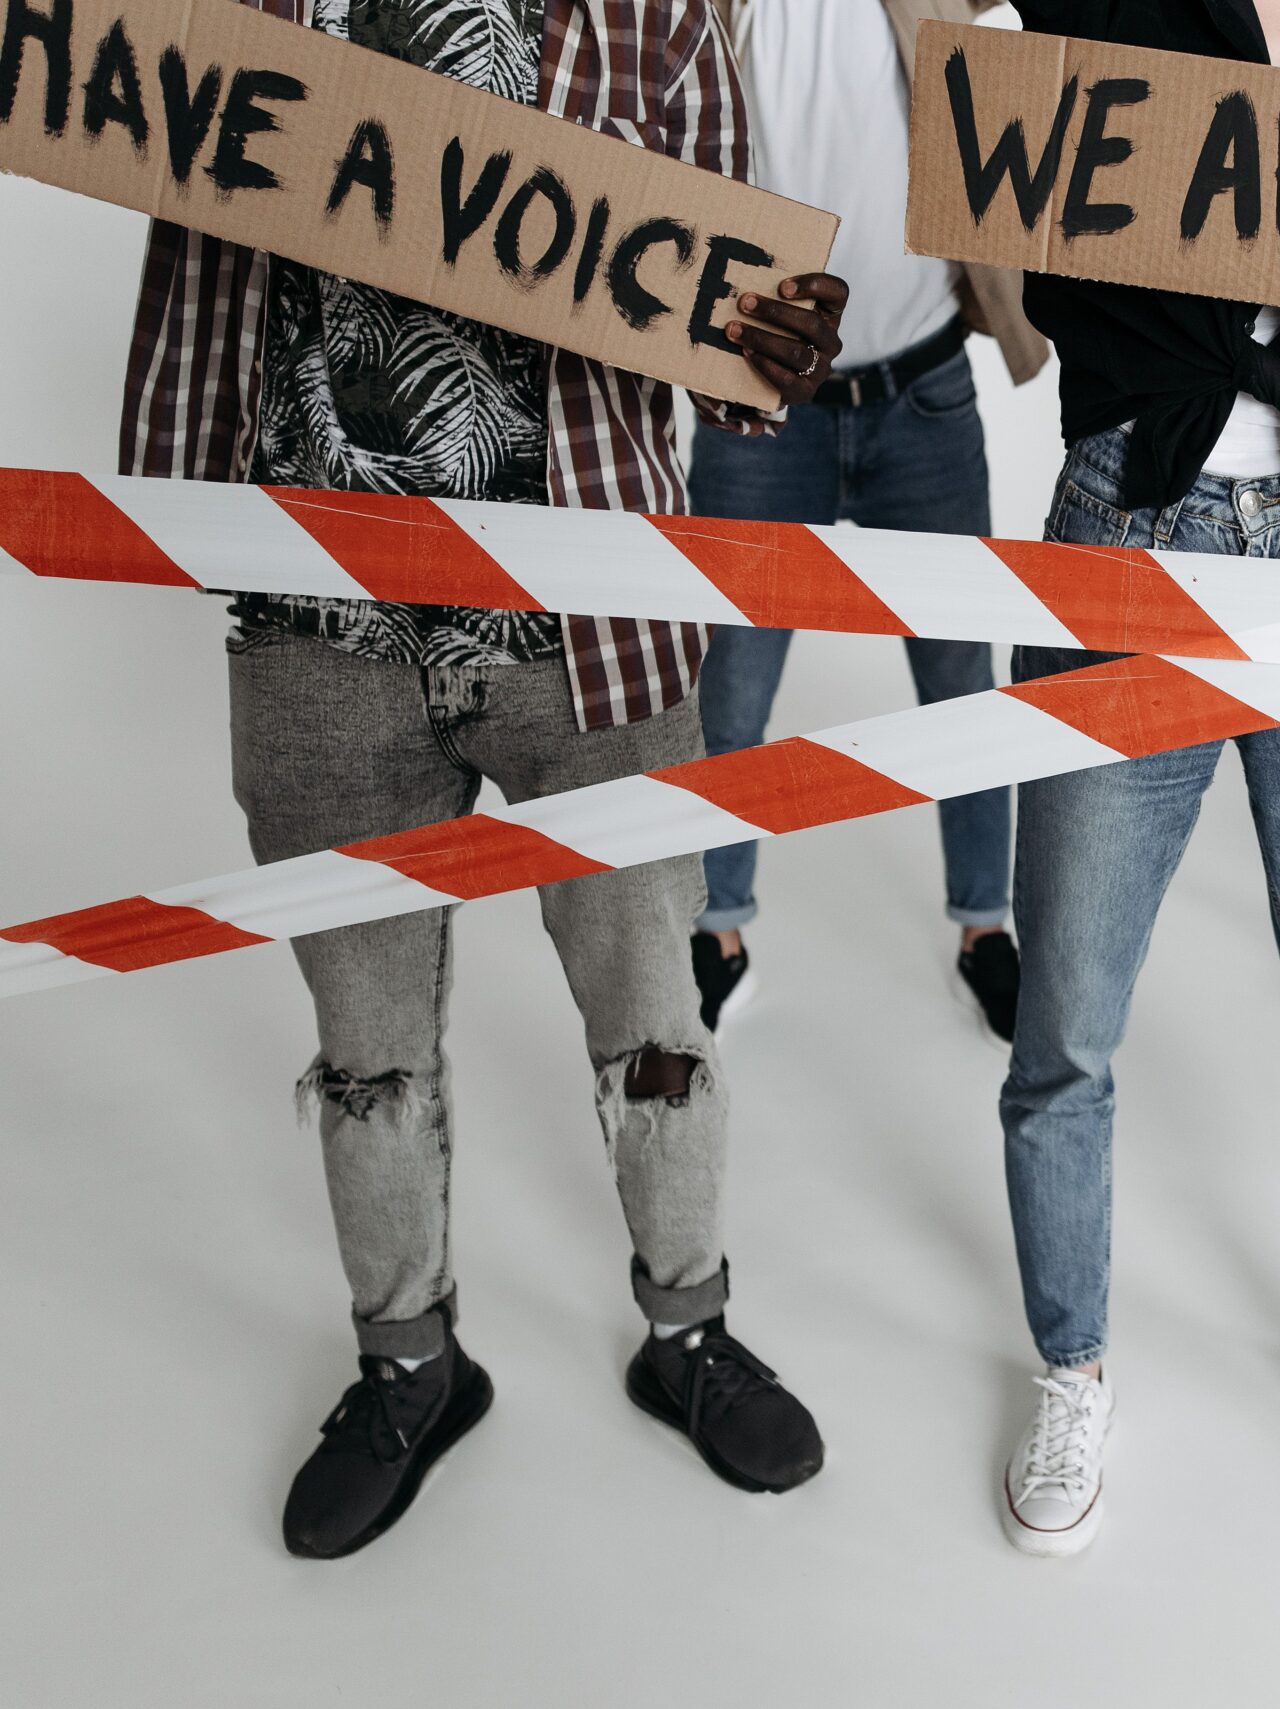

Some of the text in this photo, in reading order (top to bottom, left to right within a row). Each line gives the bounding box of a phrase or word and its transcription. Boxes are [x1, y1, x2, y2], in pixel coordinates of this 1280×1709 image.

[0, 0, 782, 357] HAVE A VOICE
[944, 45, 1152, 245] WE
